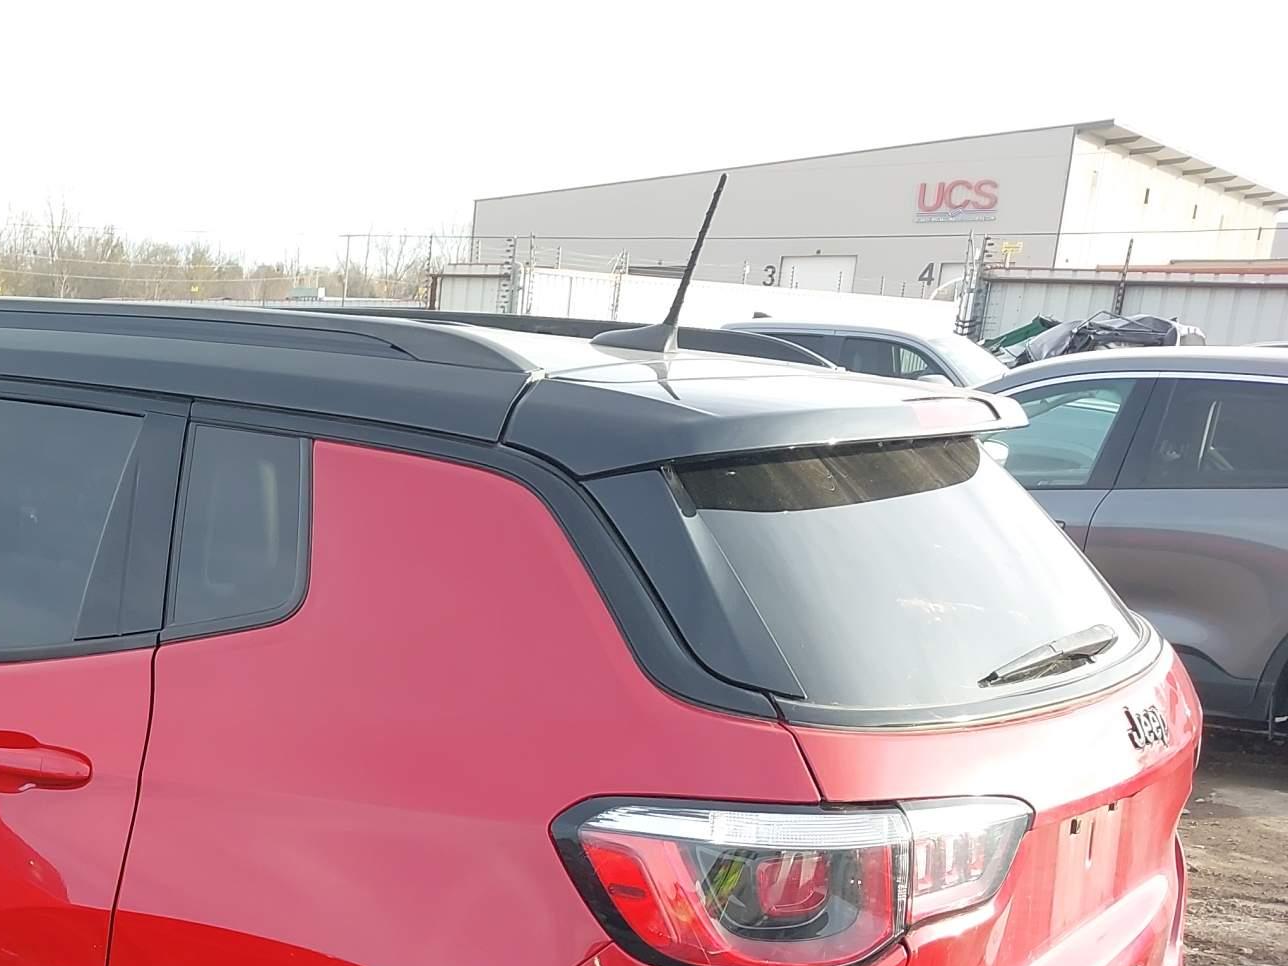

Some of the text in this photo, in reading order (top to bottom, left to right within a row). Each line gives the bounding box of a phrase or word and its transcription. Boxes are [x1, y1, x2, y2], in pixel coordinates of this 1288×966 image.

[917, 179, 998, 213] UCS
[762, 264, 777, 287] 3
[917, 262, 935, 286] 4
[1122, 705, 1169, 751] Jeep
